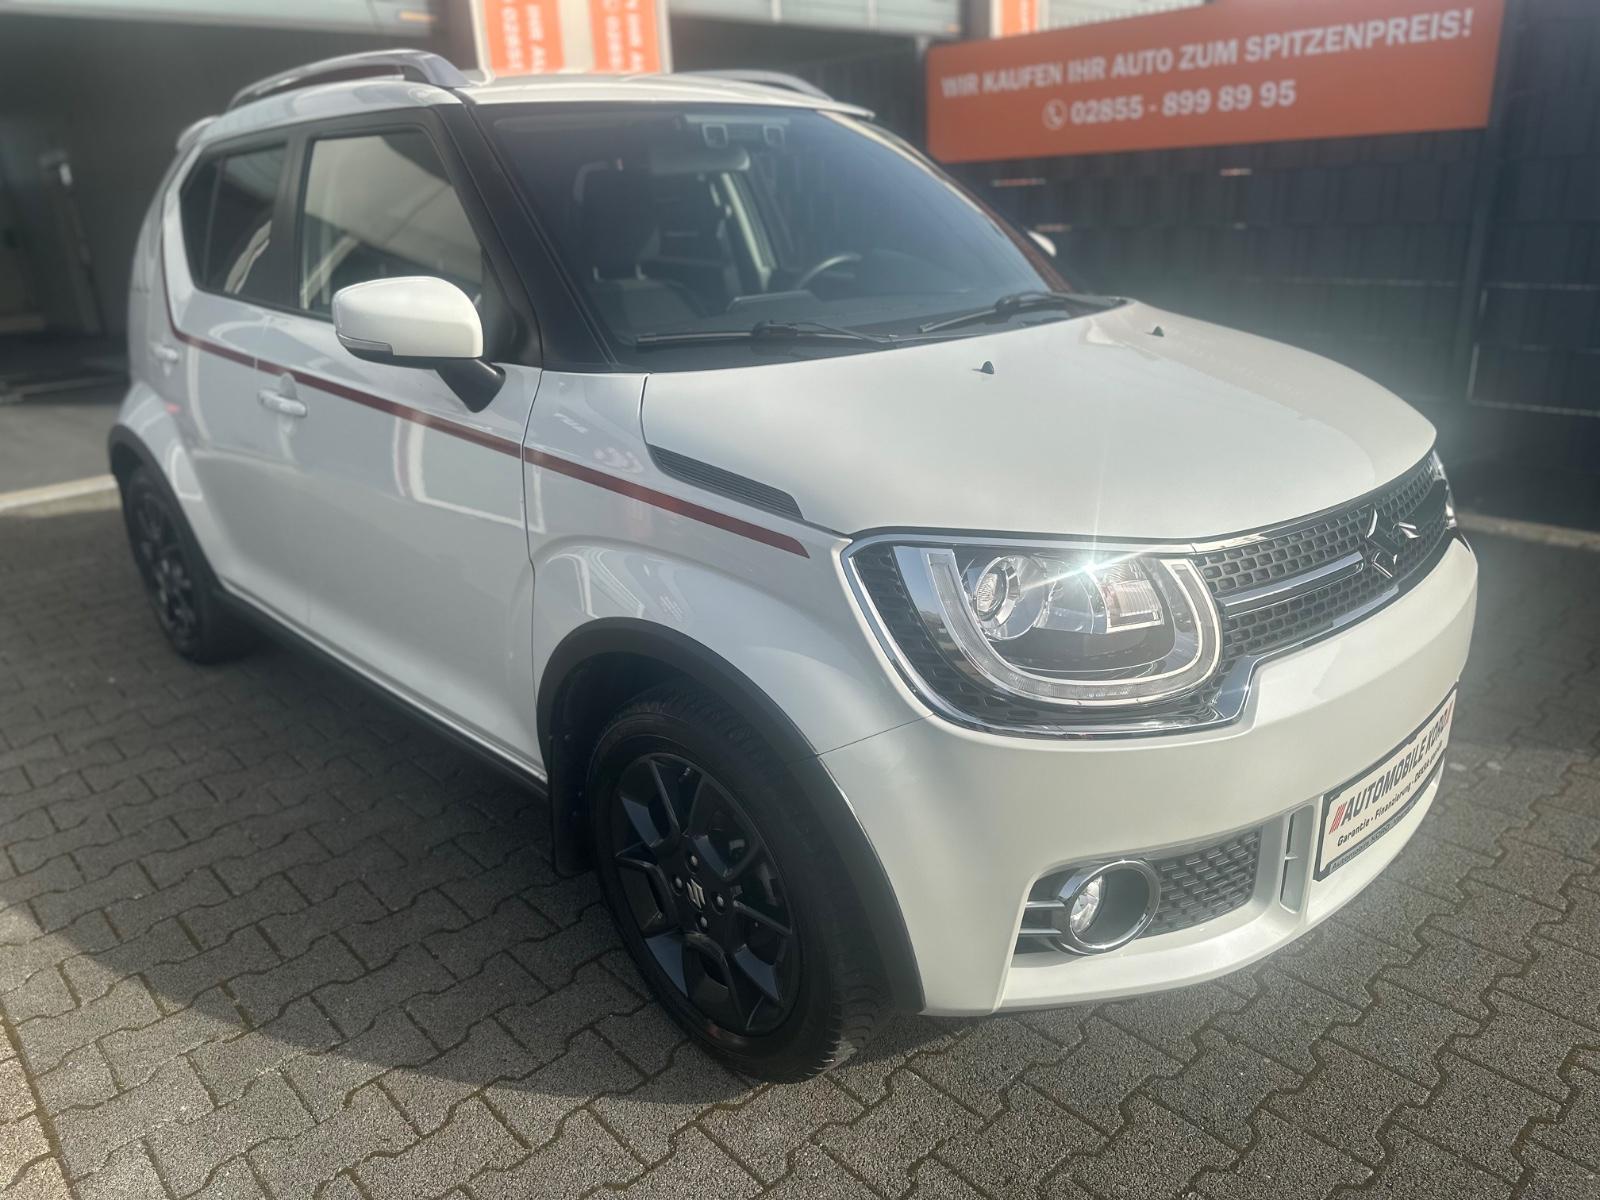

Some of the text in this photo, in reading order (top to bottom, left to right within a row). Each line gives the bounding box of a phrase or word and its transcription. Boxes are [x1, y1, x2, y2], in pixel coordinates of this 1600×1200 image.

[941, 8, 1474, 98] WIR KAUFEN IHR AUTO ZUM SPITZENPREIS!
[1070, 94, 1144, 126] 02855
[1162, 88, 1212, 117] 899
[1217, 83, 1254, 112] 89
[1259, 79, 1297, 108] 95
[1340, 735, 1427, 828] AUTOMOBILE
[1337, 815, 1370, 848] Garantie
